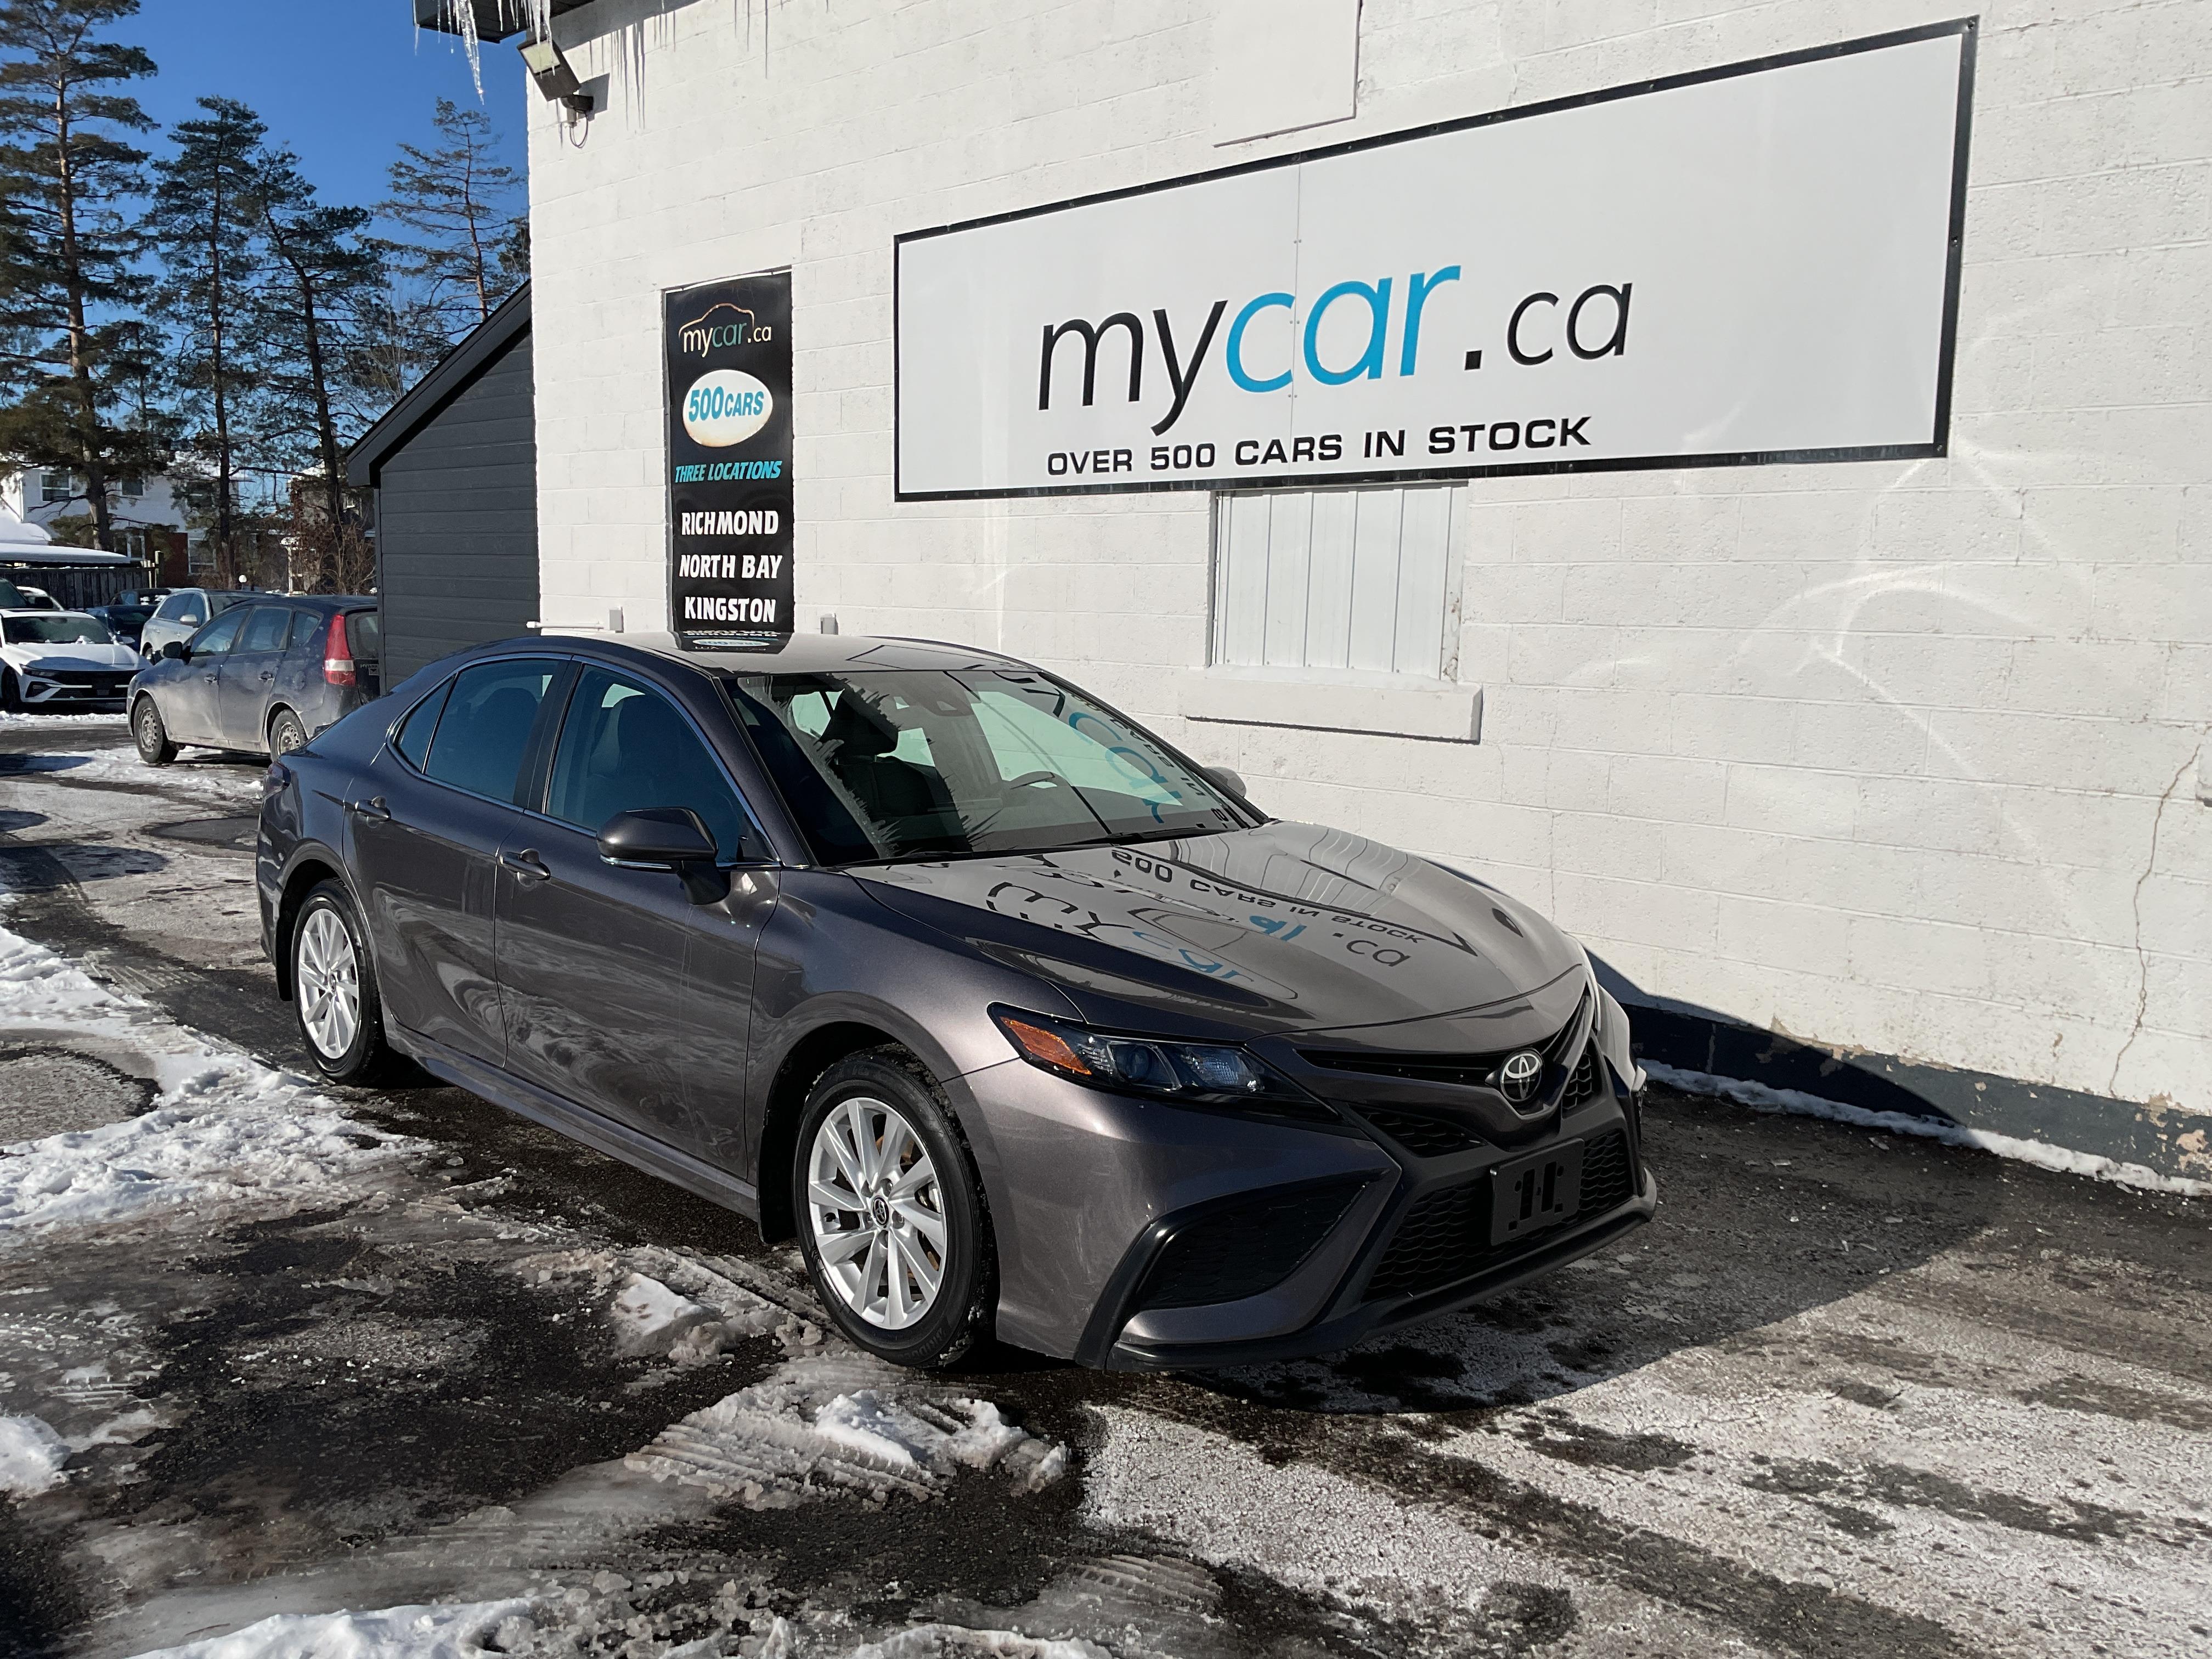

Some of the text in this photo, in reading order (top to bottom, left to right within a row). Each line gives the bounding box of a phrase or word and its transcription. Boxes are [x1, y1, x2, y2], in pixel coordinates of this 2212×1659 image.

[1048, 416, 1592, 476] OVER 500 CARS IN STOCK
[675, 460, 783, 483] THREE LOCATIONS
[681, 510, 779, 535] RICHMOND
[679, 554, 783, 579] NORTH BAY
[685, 596, 776, 623] KINGSTON
